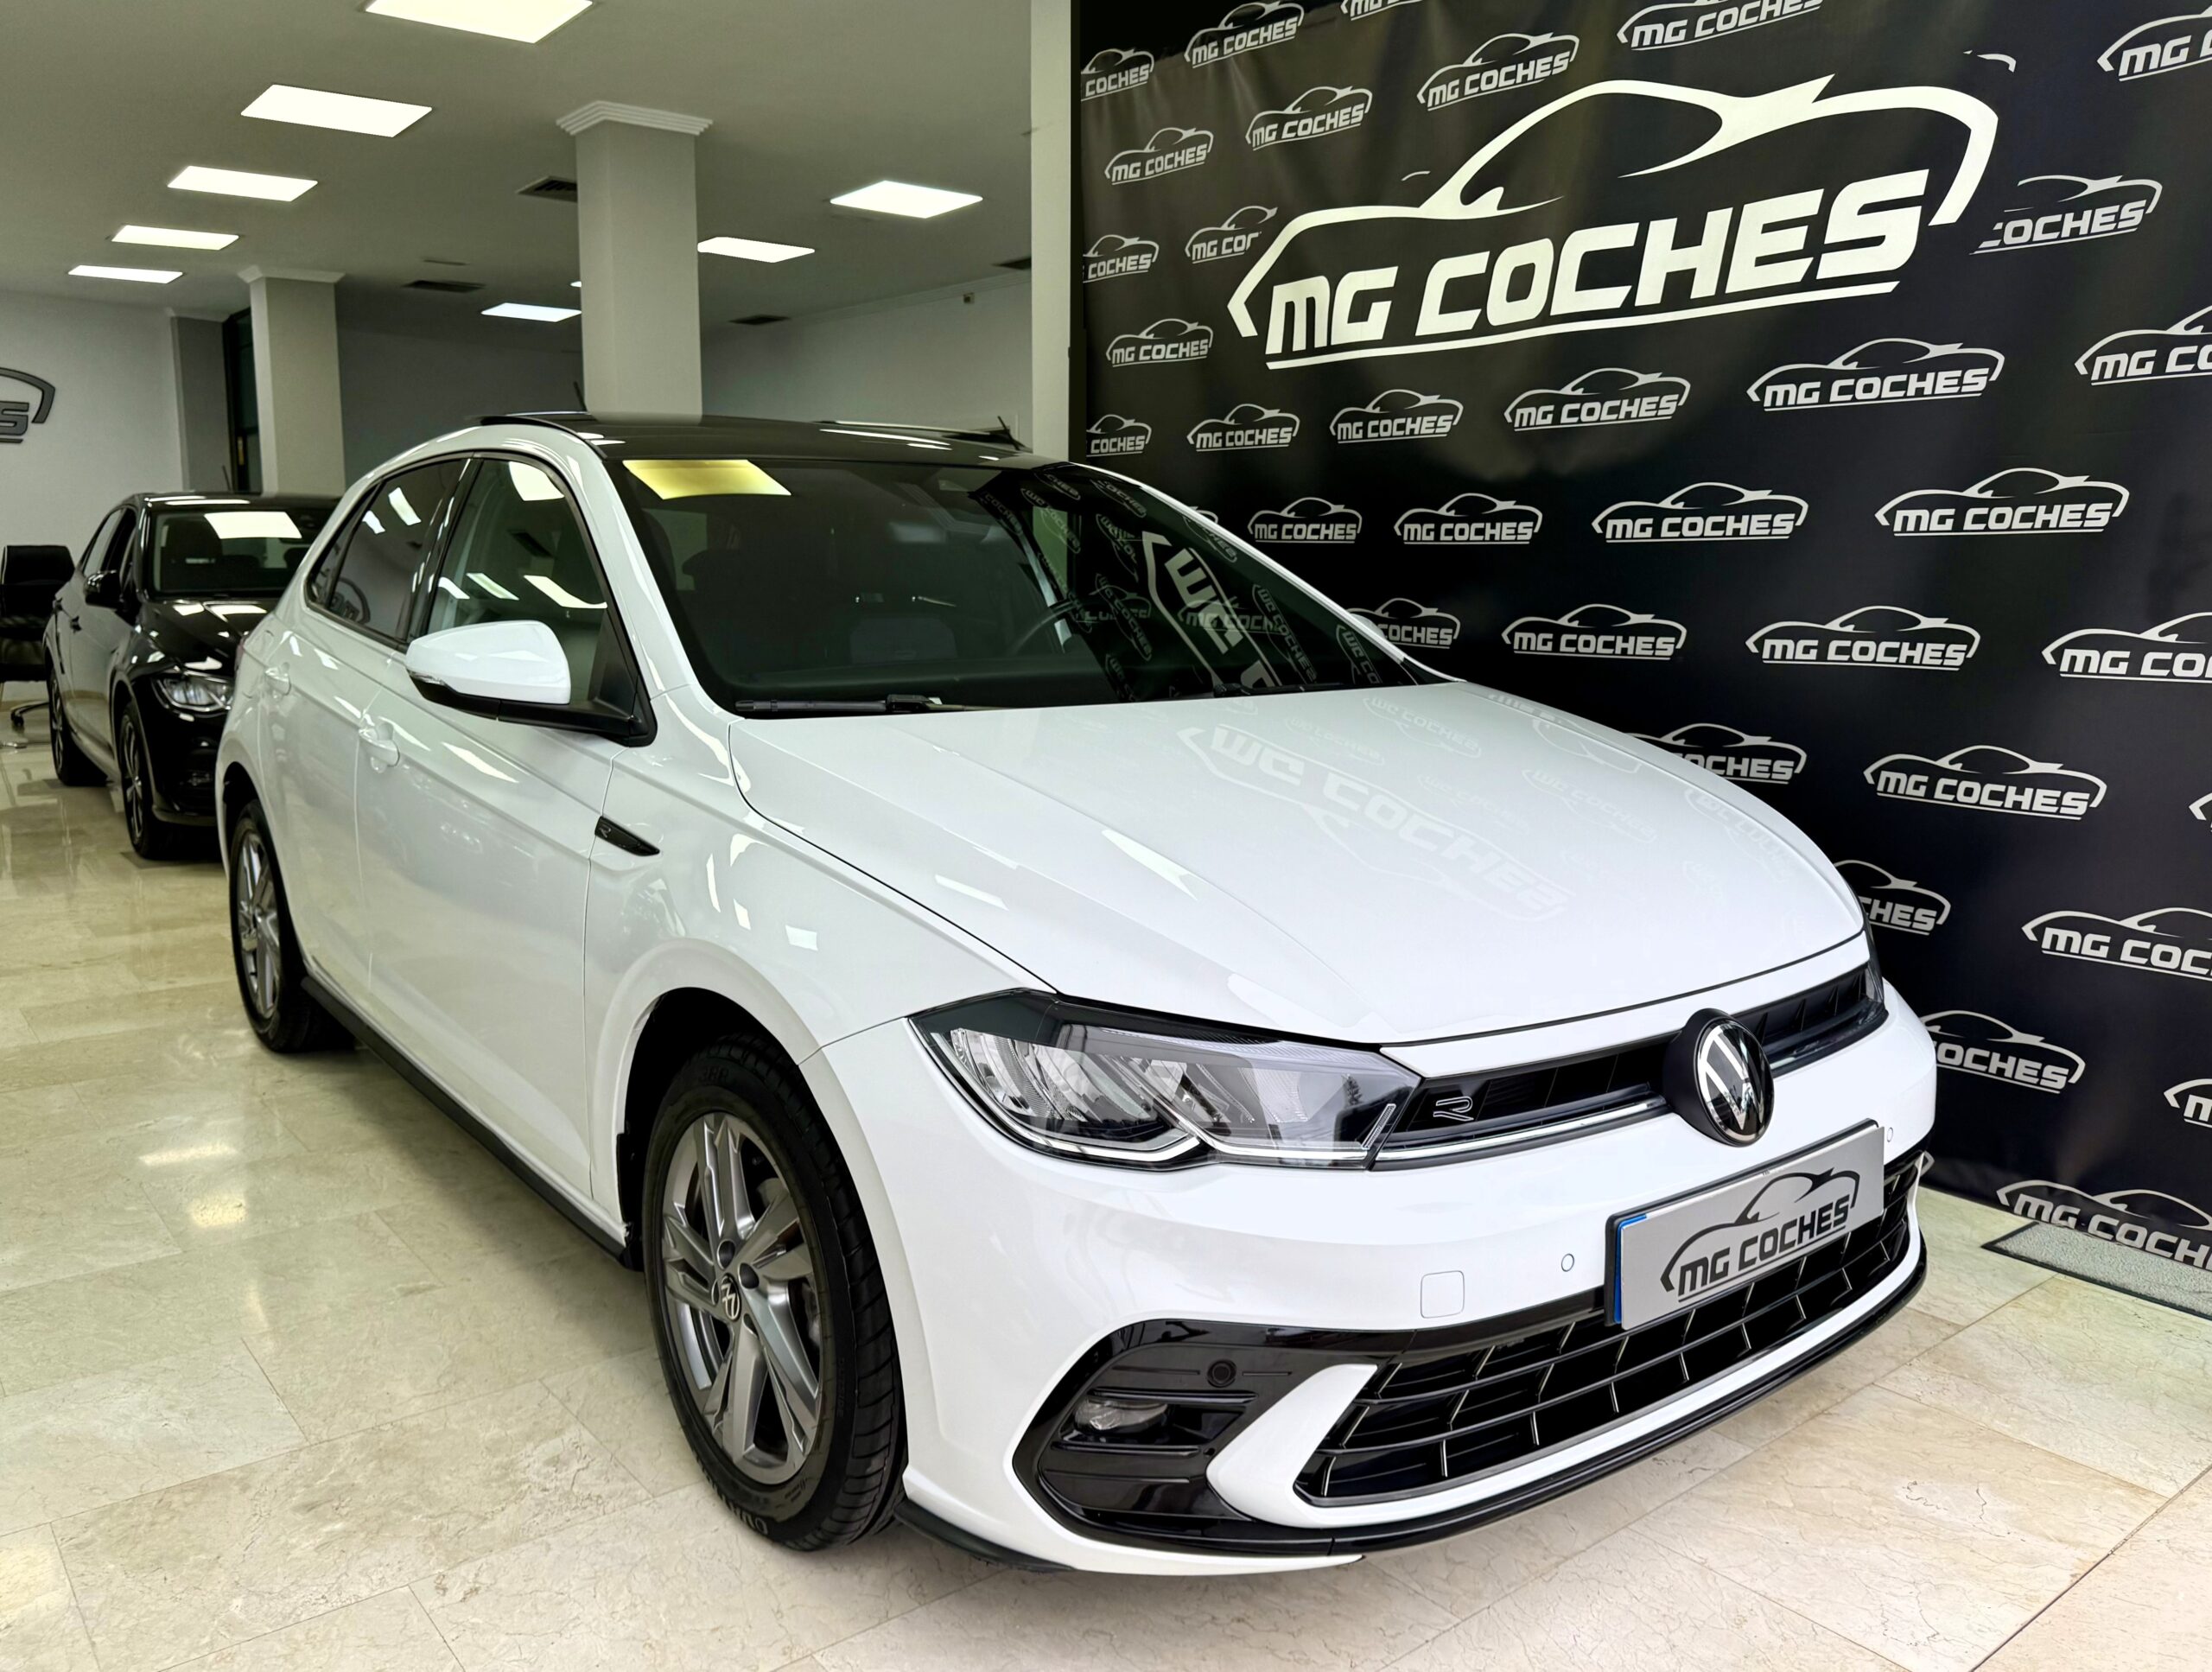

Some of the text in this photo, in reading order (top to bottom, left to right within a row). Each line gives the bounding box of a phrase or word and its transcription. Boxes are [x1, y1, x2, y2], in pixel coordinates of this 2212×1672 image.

[1631, 0, 1823, 48] MG COCHE
[1192, 16, 1298, 65] MG COCHES
[2118, 35, 2192, 77] MG
[1085, 63, 1150, 98] COCHES
[1427, 51, 1571, 107] MG COCHES
[1252, 103, 1365, 147] MG COCHES
[1111, 143, 1208, 182] MG COCHES
[1088, 253, 1153, 279] COCHES
[1192, 239, 1218, 261] MG
[1265, 168, 1929, 355] MG COCHES
[1112, 339, 1209, 365] MG COCHES
[2091, 349, 2157, 381] MG
[1764, 367, 1990, 407] MG COCHES
[1514, 393, 1679, 428] MG COCHES
[1196, 427, 1293, 449] MG COCHES
[1337, 415, 1454, 441] MG COCHES
[1090, 435, 1146, 454] COCHES
[1255, 523, 1357, 540] MG COCHES
[1403, 521, 1535, 541] MG COCHES
[1605, 513, 1796, 539] MG COCHES
[1893, 502, 2113, 532] MG COCHES
[1513, 632, 1676, 657] MG COCHES
[1762, 639, 1967, 666] MG COCHES
[2059, 648, 2212, 678] MG CO
[1674, 753, 1795, 780] OCHES
[1877, 771, 2091, 816] MG COCHES
[2041, 926, 2112, 958] MG
[1934, 1042, 2069, 1090] OCHES
[1678, 1194, 1850, 1296] MG COCHES
[2013, 1193, 2212, 1271] MG COCH
